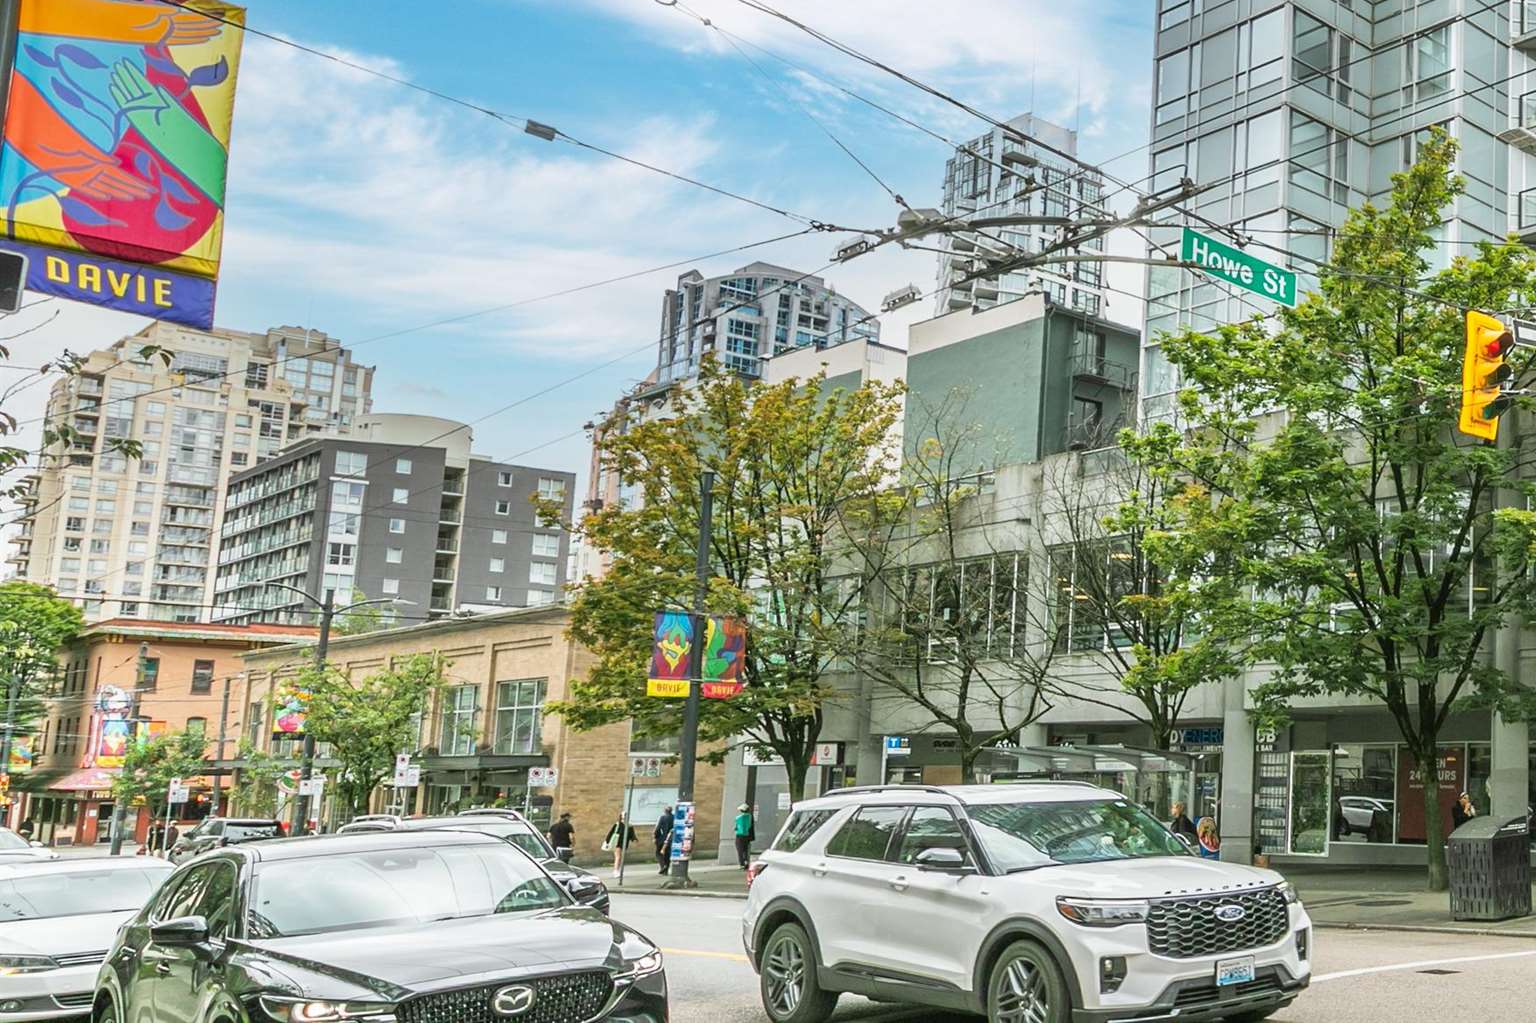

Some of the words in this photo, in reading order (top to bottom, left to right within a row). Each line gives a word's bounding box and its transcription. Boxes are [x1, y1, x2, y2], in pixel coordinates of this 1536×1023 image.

[46, 255, 174, 308] DAVIE
[1191, 237, 1254, 285] Howe
[1263, 268, 1287, 298] St
[1169, 728, 1185, 744] DY
[1438, 770, 1457, 781] URS
